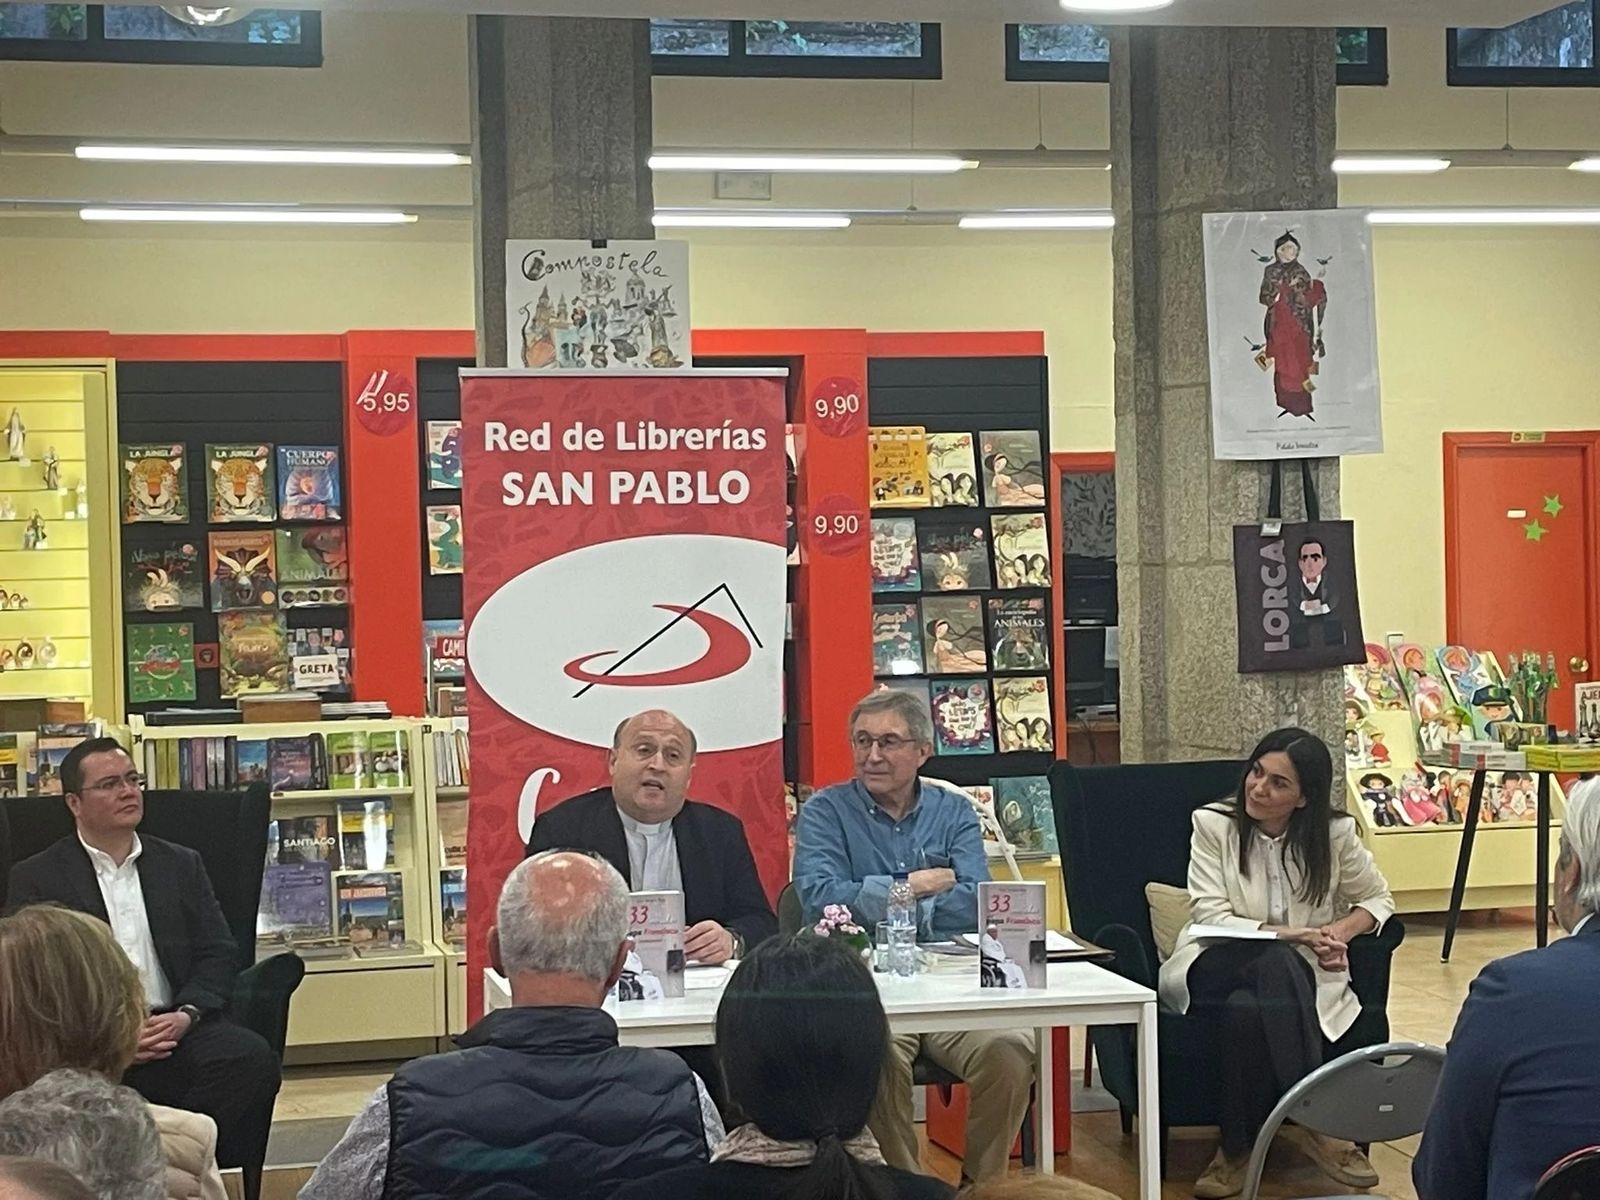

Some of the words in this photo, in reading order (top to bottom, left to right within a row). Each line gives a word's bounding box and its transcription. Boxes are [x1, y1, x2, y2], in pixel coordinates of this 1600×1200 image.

[521, 249, 669, 281] Compostela
[815, 394, 859, 419] 9,90
[484, 421, 551, 451] Red
[562, 421, 605, 451] de
[616, 419, 767, 452] Librerías
[502, 471, 594, 506] SAN
[610, 470, 750, 505] PABLO
[814, 514, 859, 537] 9,90
[1259, 538, 1291, 653] LORCA
[994, 618, 1045, 628] ANIMALES
[299, 663, 334, 675] GRETA
[1580, 689, 1600, 701] AJE
[283, 837, 336, 848] SANTIAGO
[990, 894, 1011, 913] 33
[630, 905, 649, 925] 33
